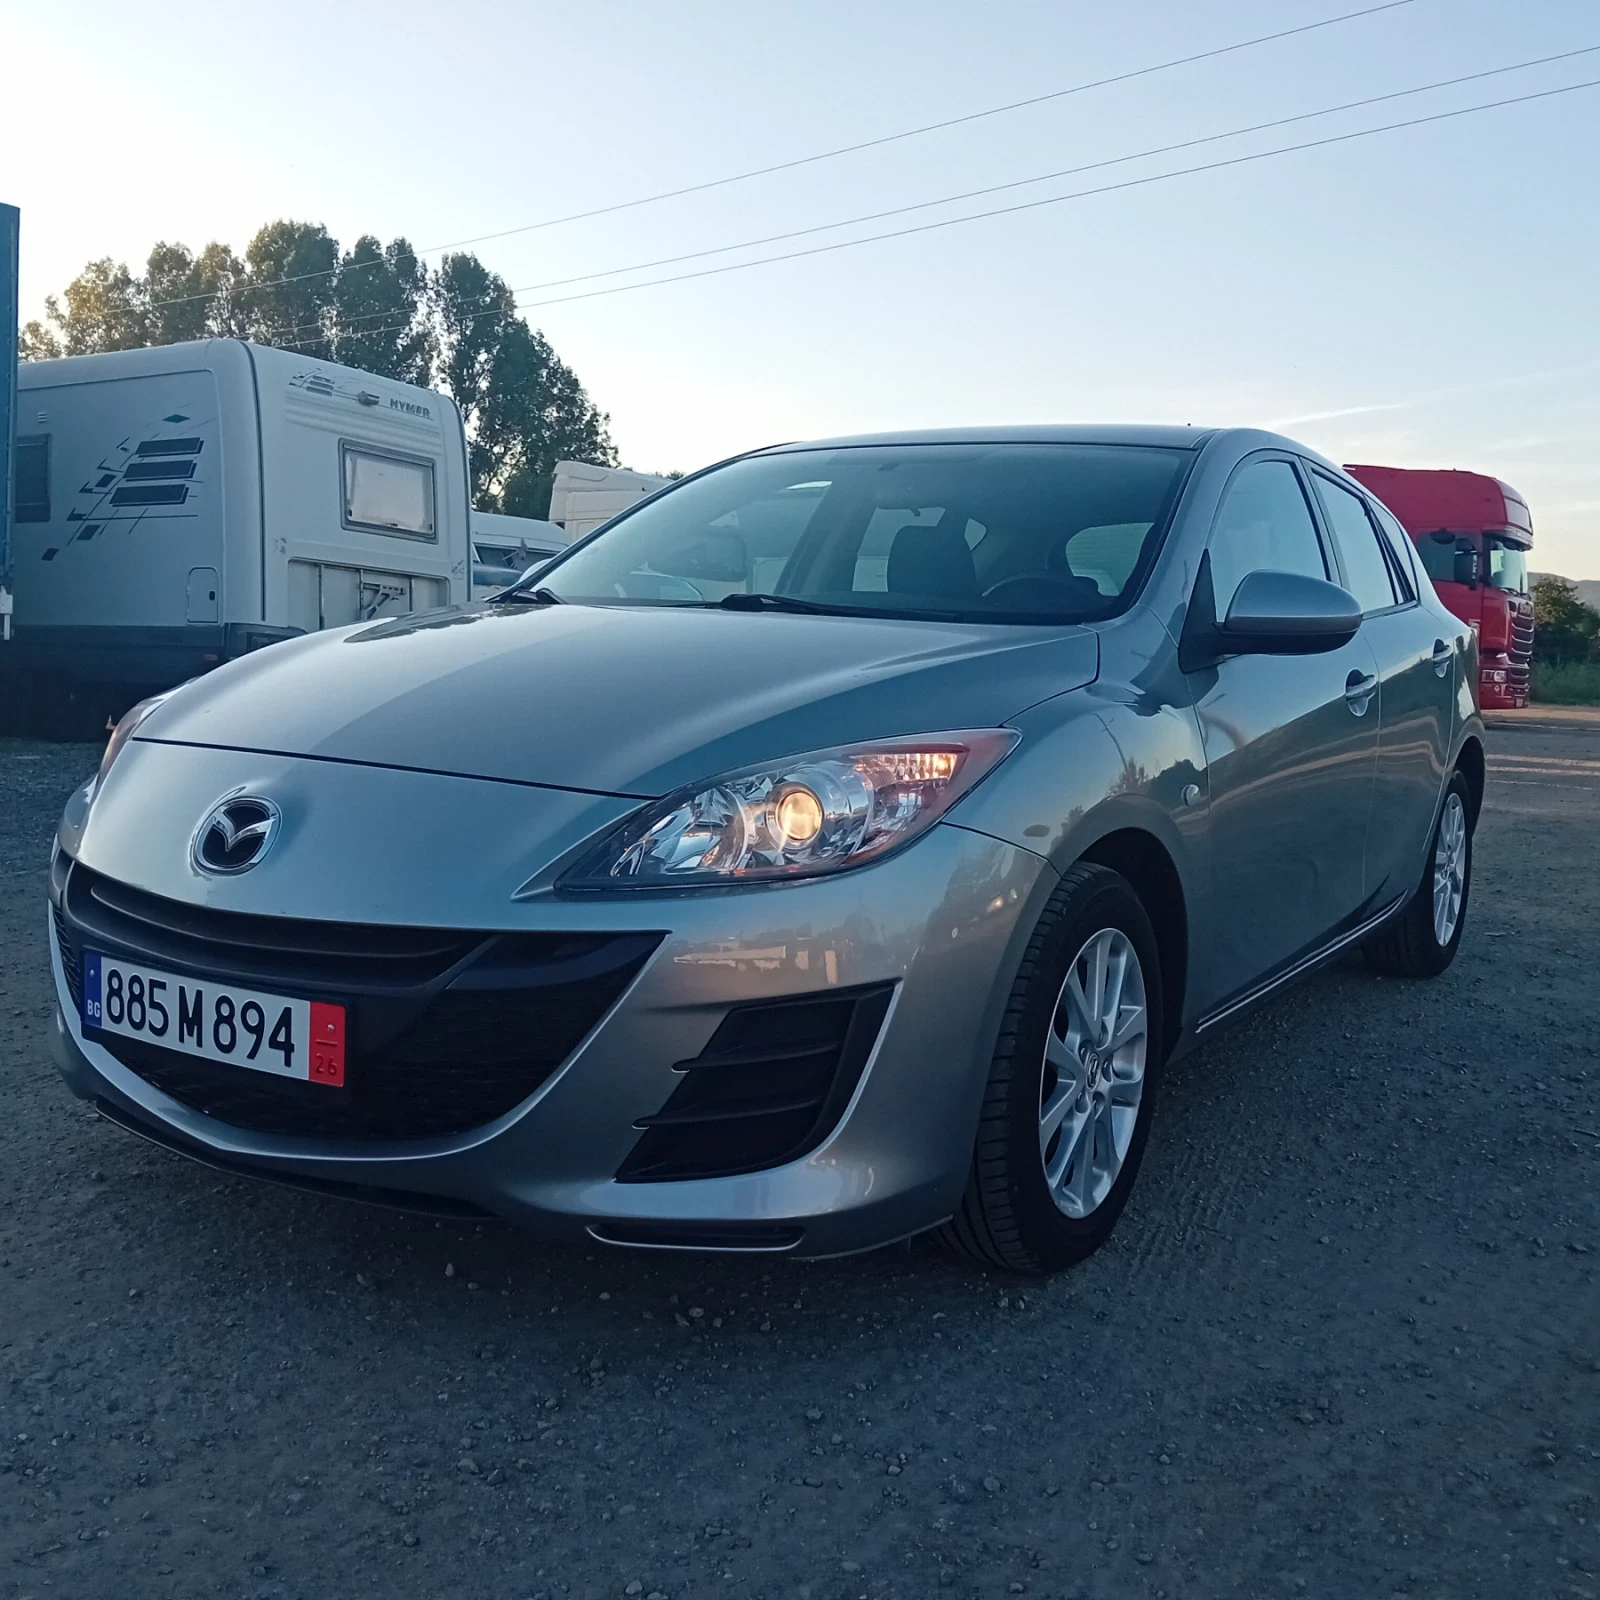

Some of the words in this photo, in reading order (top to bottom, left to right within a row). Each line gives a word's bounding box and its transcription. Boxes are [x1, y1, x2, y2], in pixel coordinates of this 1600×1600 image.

[390, 397, 430, 418] HYMER
[87, 998, 101, 1018] BG
[105, 968, 170, 1037] 885
[212, 994, 295, 1068] 894
[315, 1052, 338, 1076] 26
